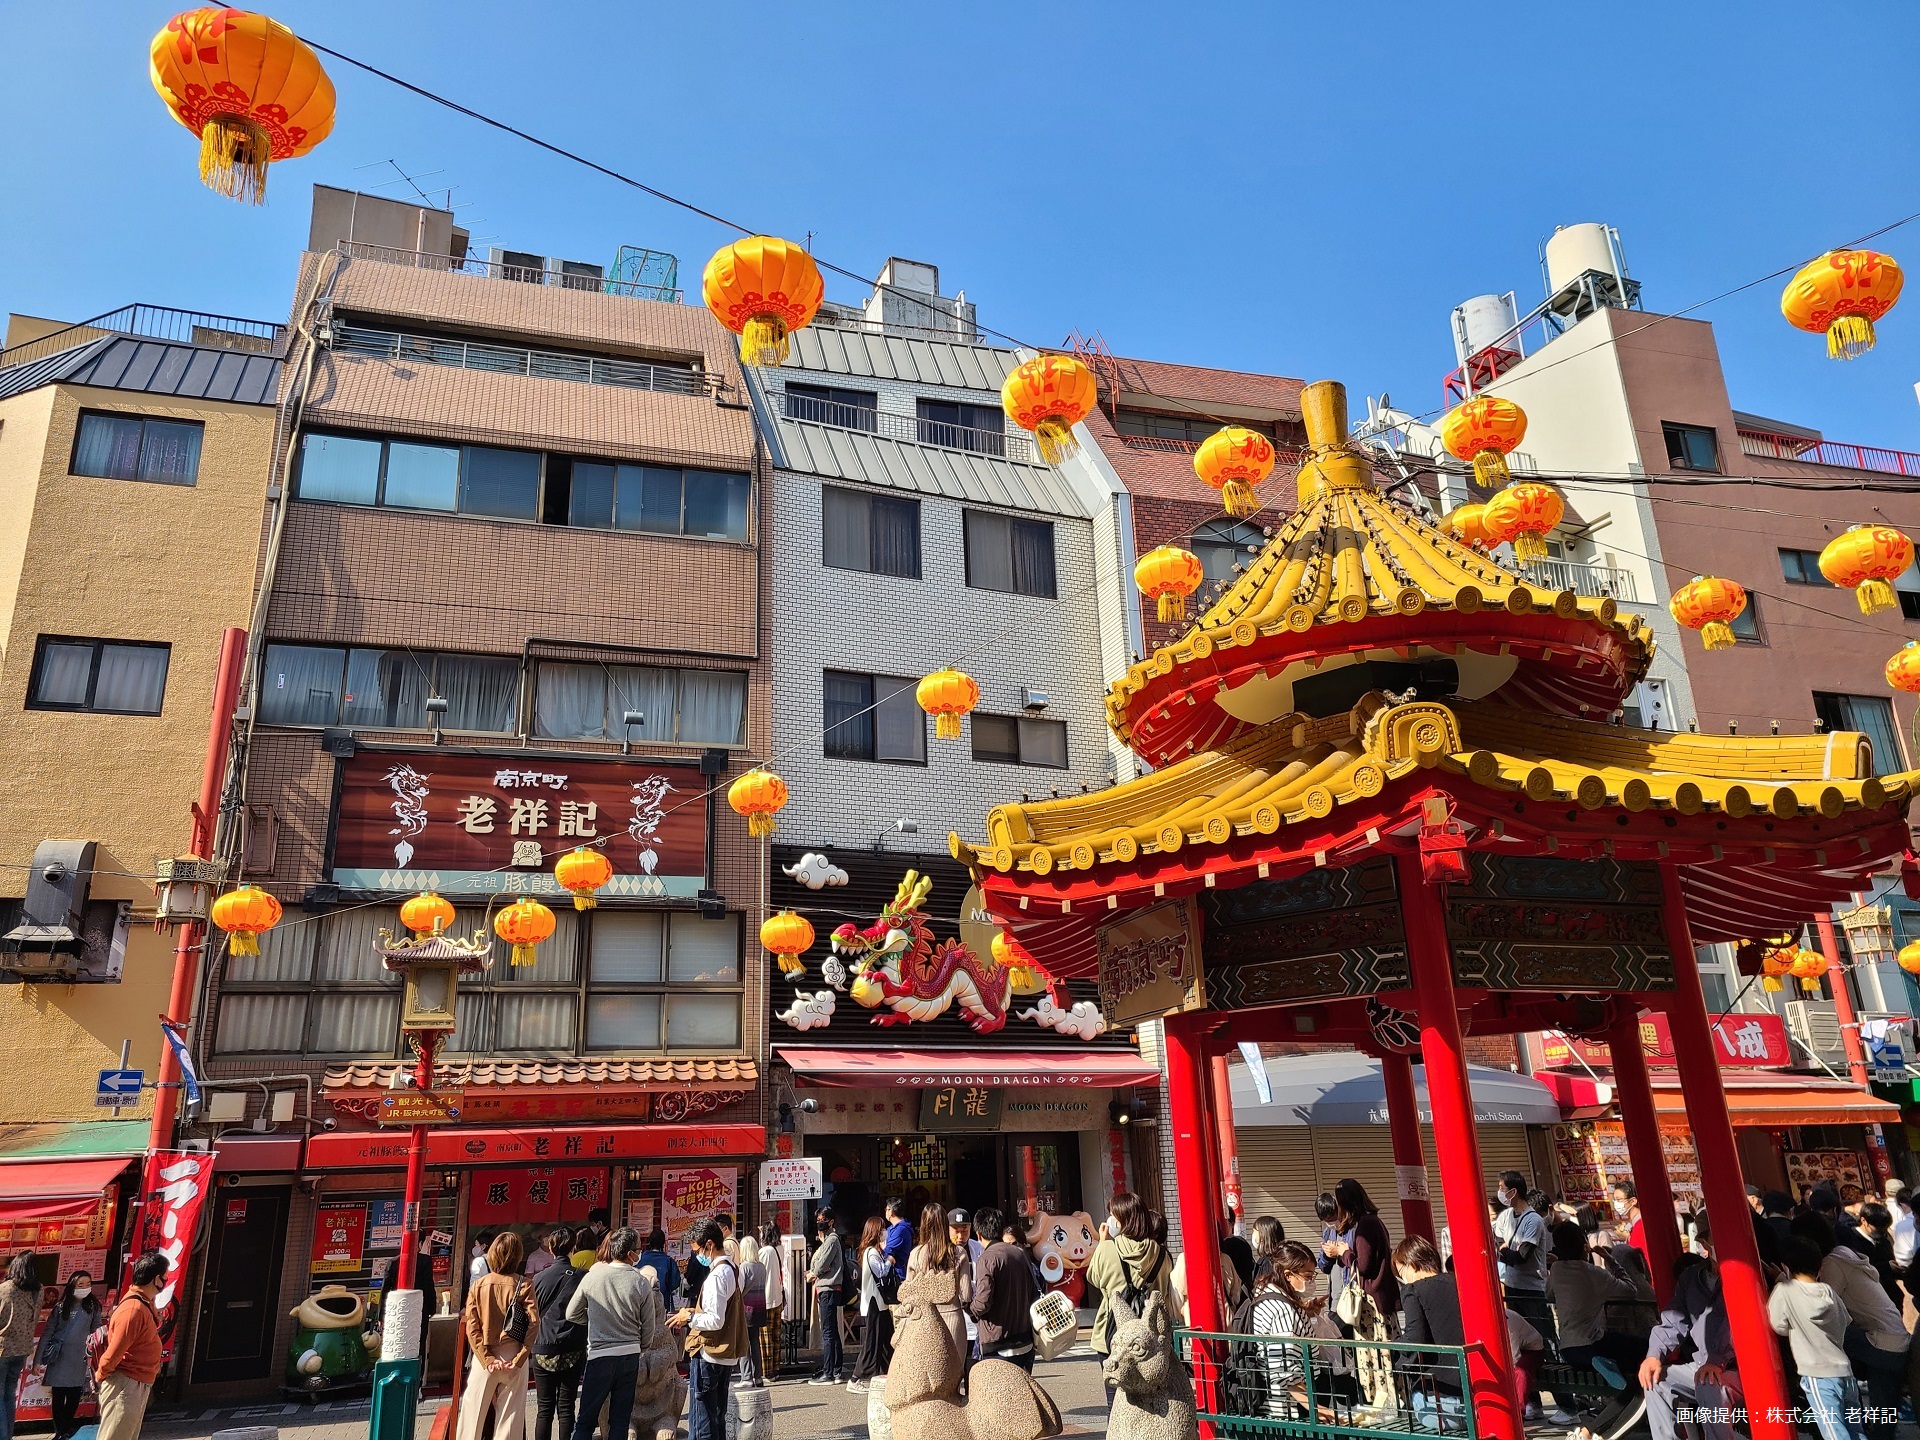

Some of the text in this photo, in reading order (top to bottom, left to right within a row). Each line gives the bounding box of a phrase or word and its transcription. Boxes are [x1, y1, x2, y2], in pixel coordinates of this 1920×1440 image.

[494, 769, 568, 790] 南京町
[455, 796, 598, 837] 老祥記
[467, 873, 571, 894] 元祖 豚饅
[941, 1076, 1051, 1085] MOON DRAGON
[398, 1097, 456, 1106] 観光トイレ
[934, 1087, 990, 1117] 月龍
[1009, 1102, 1089, 1111] MOON DRAGON
[1501, 1112, 1523, 1121] Stand
[497, 1143, 522, 1153] 南京町
[532, 1135, 615, 1156] 老祥記
[667, 1136, 728, 1148] 創業大正四年
[688, 1177, 720, 1193] KOBE
[766, 1178, 815, 1186] お並びください
[486, 1177, 589, 1205] 豚饅頭
[690, 1198, 718, 1214] 2020
[325, 1216, 358, 1228] 老祥記
